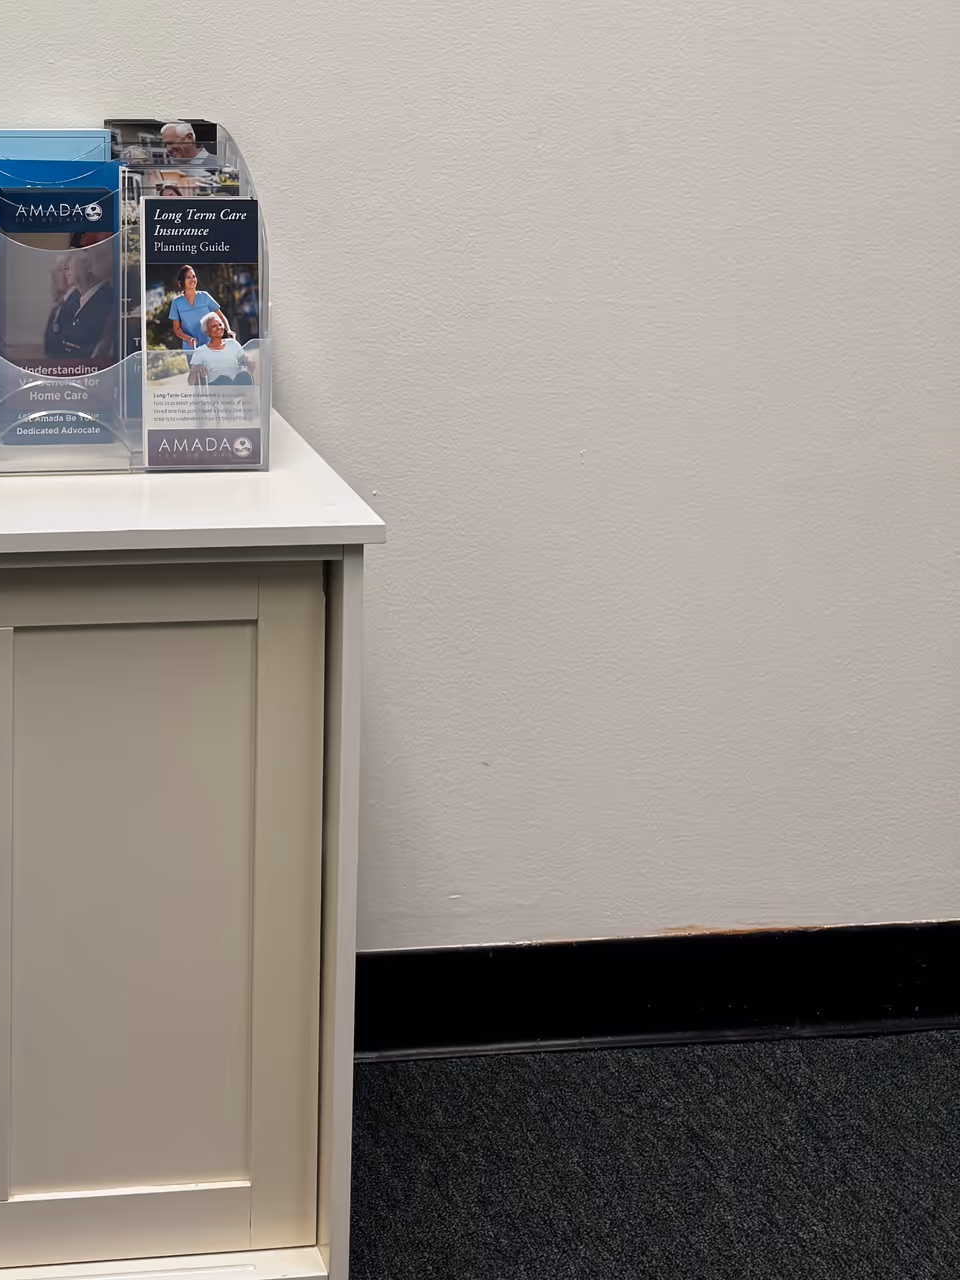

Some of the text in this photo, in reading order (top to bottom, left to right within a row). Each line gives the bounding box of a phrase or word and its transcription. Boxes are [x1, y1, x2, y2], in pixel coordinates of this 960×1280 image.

[16, 204, 83, 217] AMADA
[154, 208, 246, 223] Long Term Care
[154, 225, 209, 236] Insurance
[154, 242, 230, 254] Planning Guide
[30, 391, 88, 400] Home Care
[159, 438, 231, 452] AMADA
